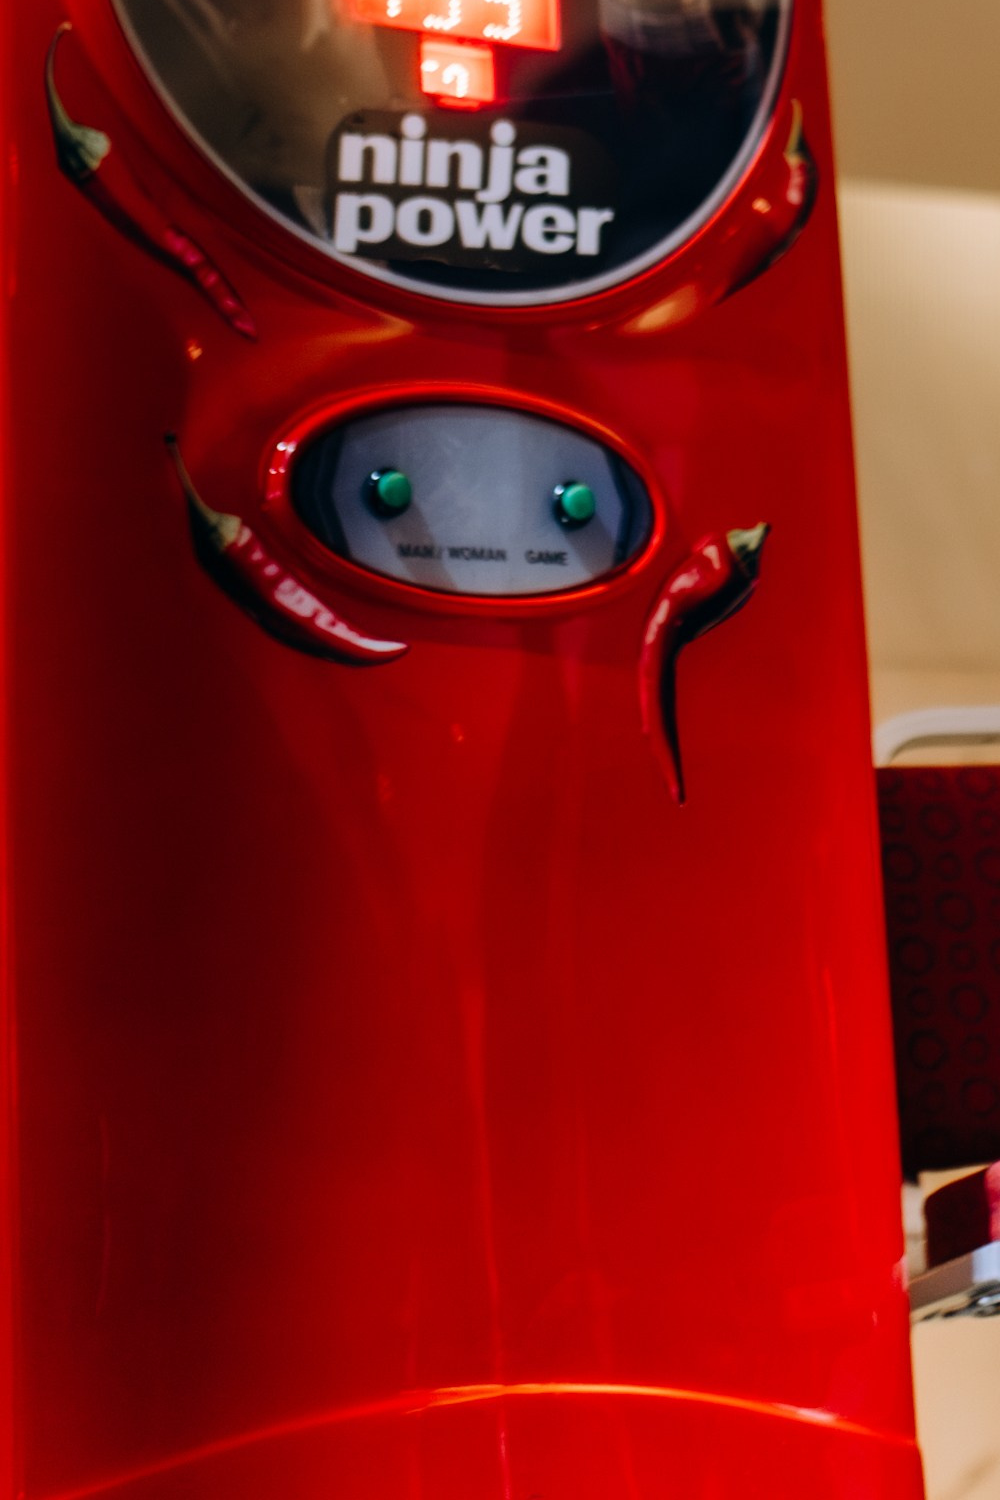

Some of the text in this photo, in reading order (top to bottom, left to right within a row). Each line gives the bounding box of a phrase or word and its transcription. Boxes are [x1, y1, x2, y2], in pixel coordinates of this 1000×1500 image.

[338, 113, 570, 202] ninja
[334, 193, 614, 256] power
[448, 547, 507, 562] WOMAN
[525, 549, 569, 566] GAME
